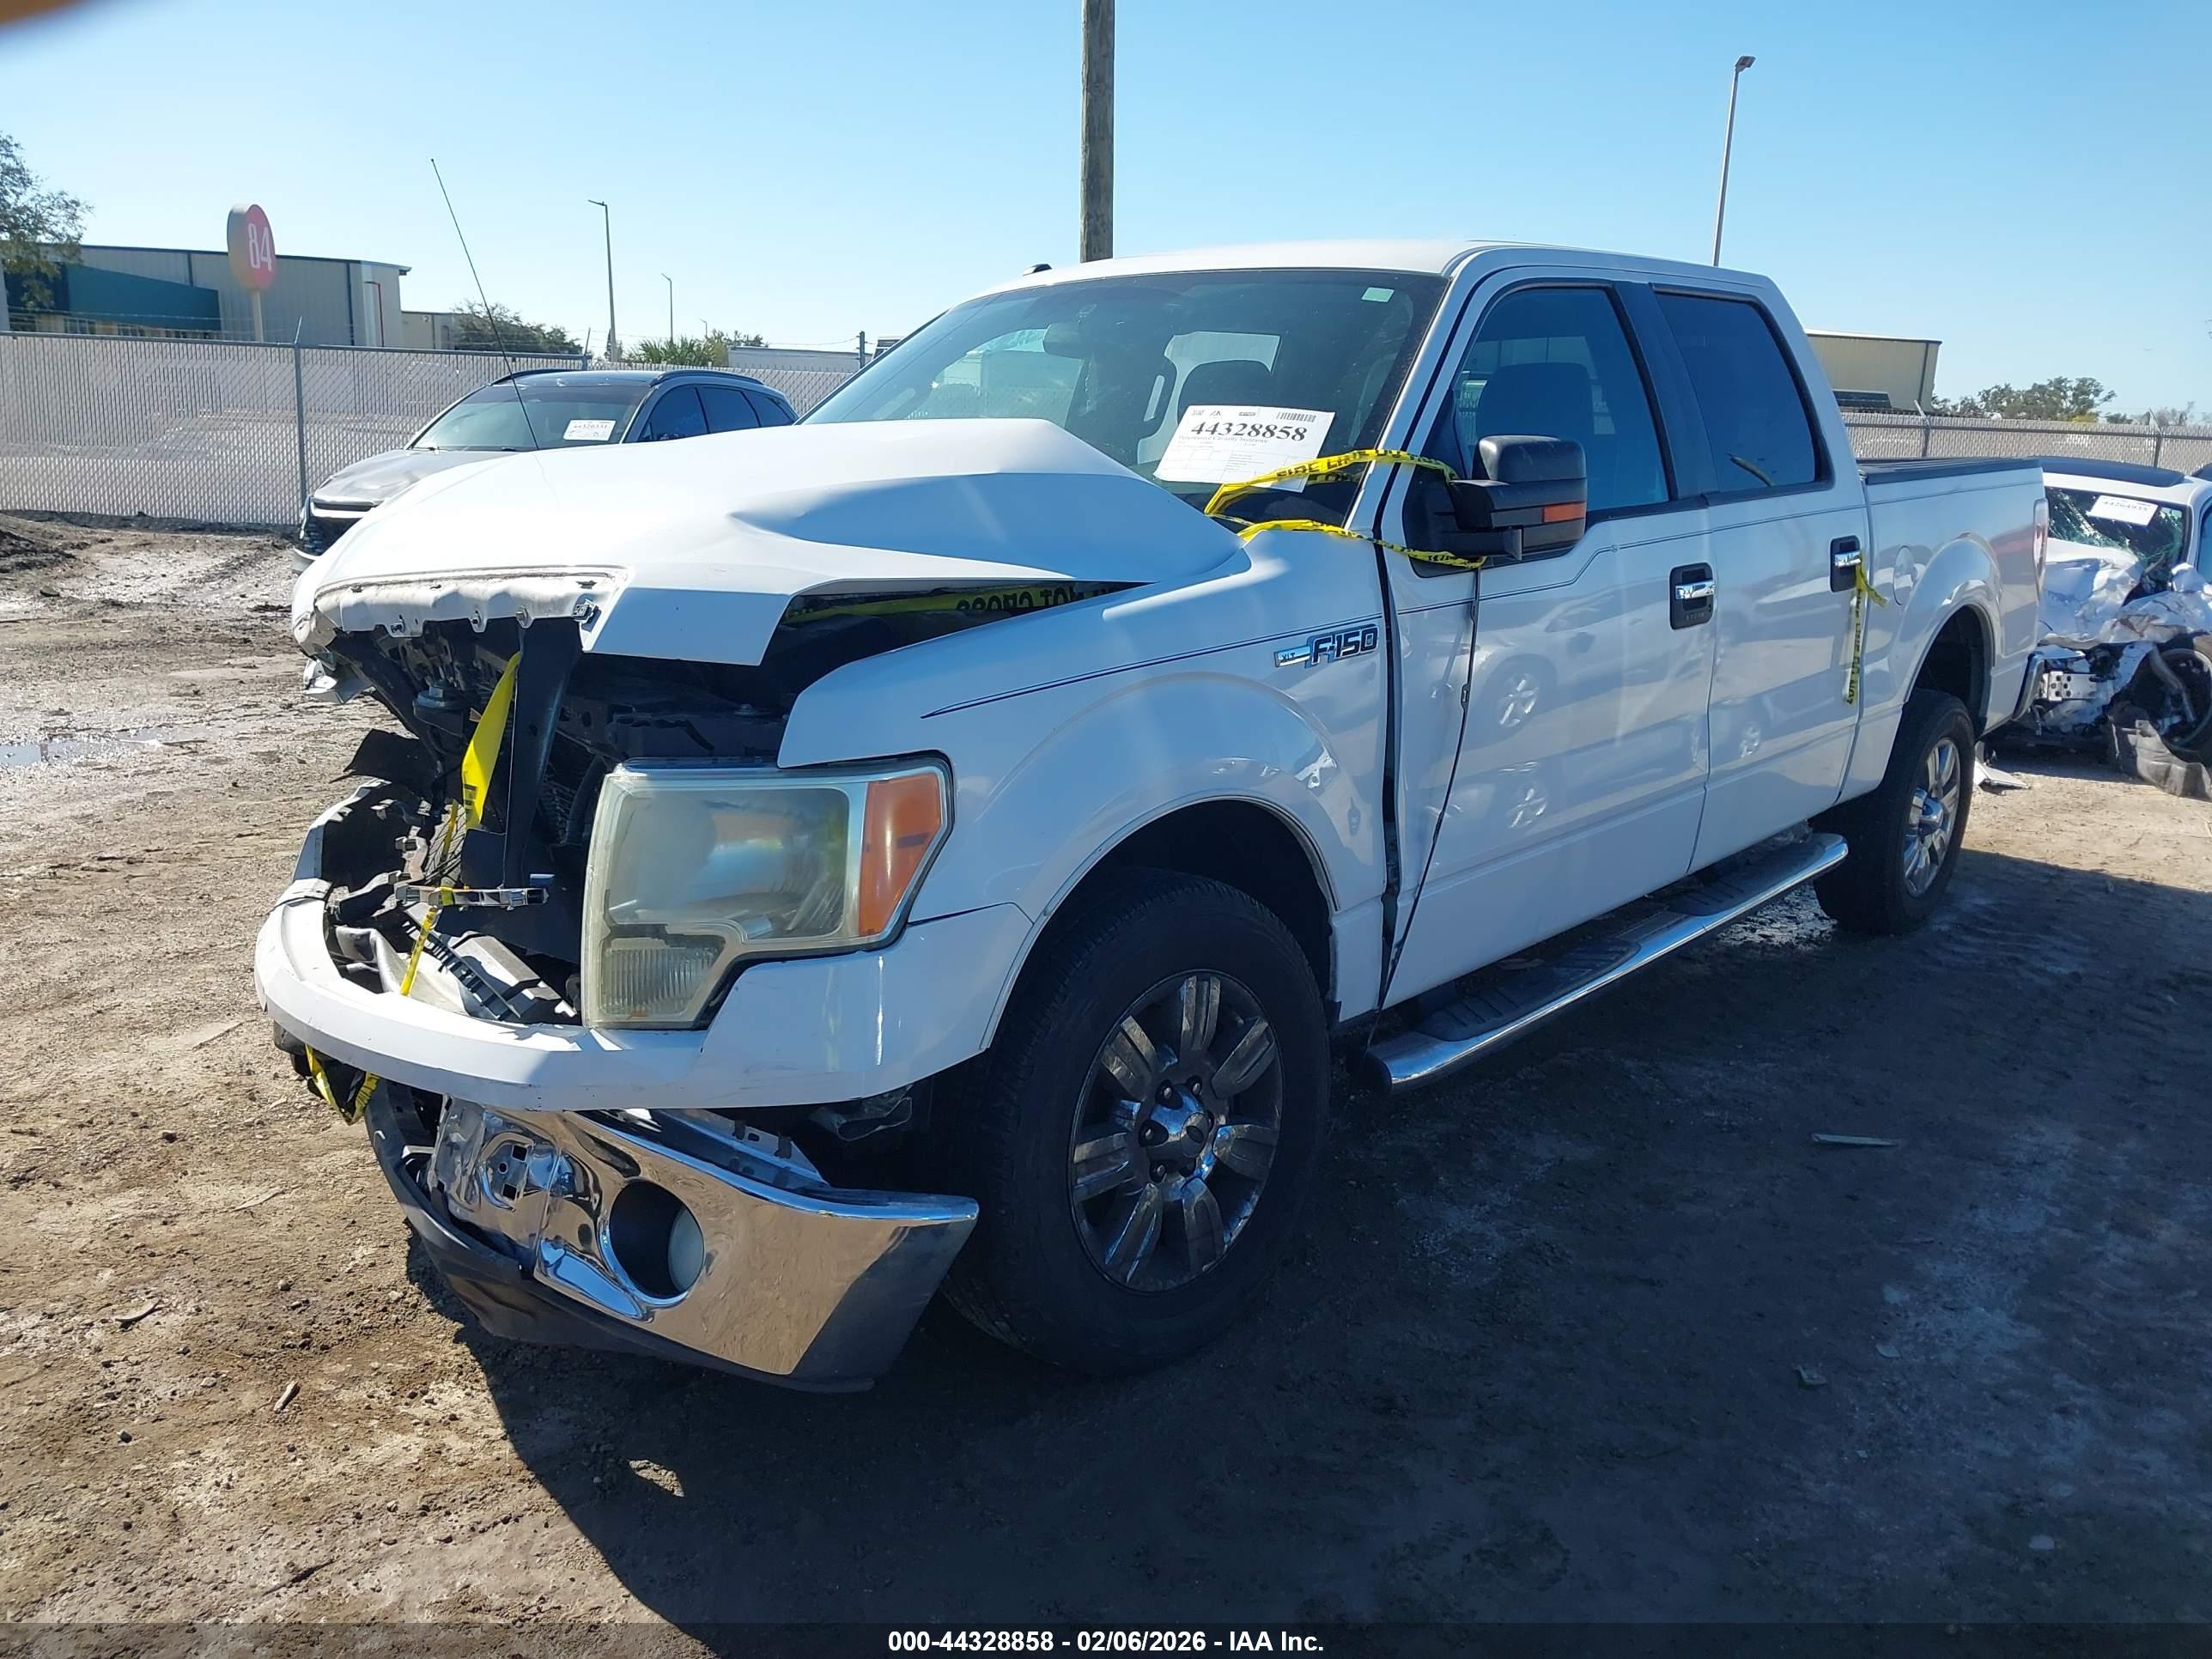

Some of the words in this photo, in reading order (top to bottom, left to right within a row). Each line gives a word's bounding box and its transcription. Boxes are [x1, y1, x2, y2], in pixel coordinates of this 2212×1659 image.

[247, 222, 272, 272] 84
[1191, 421, 1308, 441] 44328858
[1282, 652, 1297, 661] XLT
[1311, 627, 1378, 665] F-150
